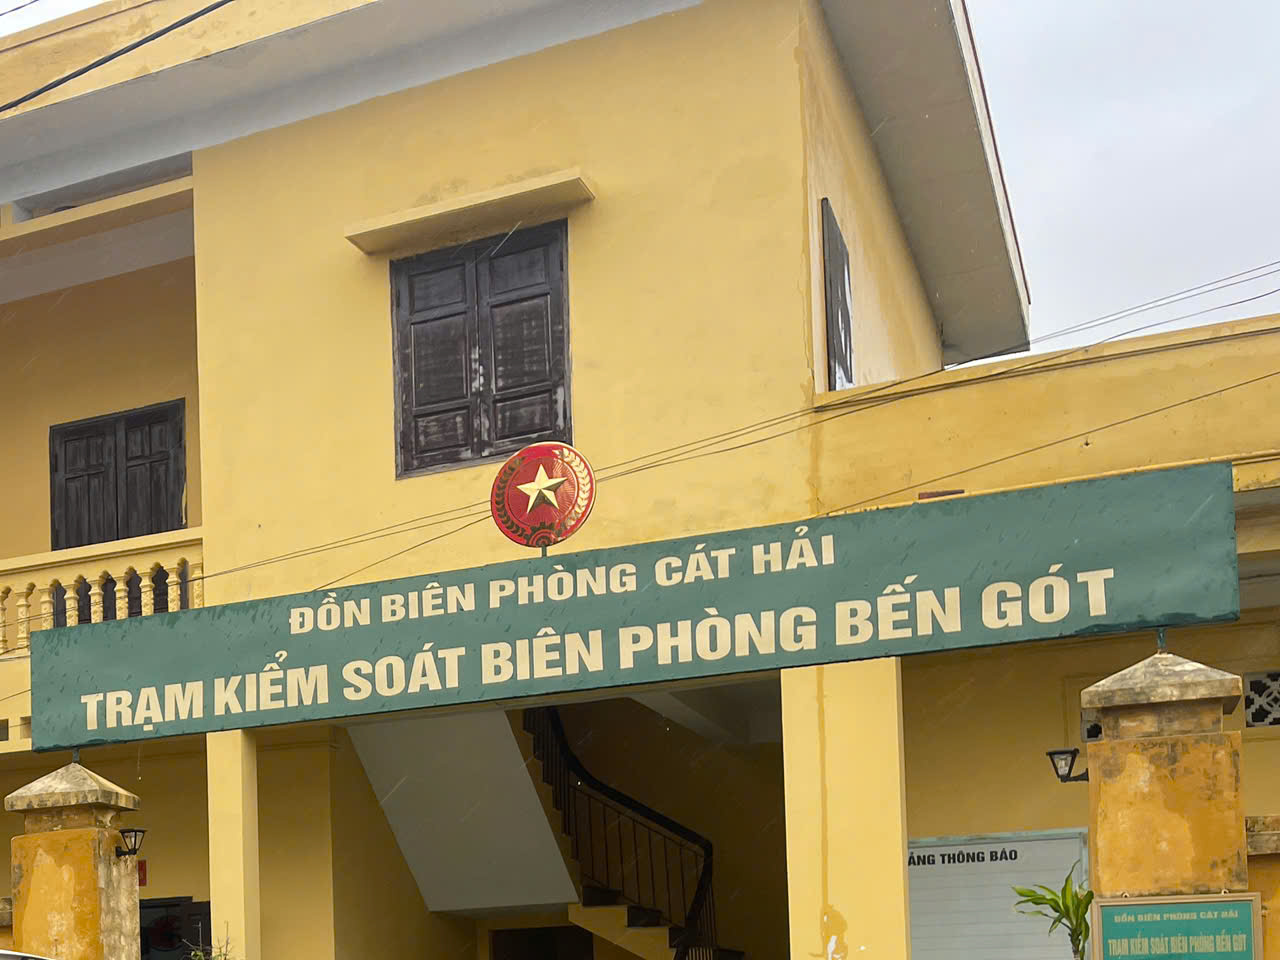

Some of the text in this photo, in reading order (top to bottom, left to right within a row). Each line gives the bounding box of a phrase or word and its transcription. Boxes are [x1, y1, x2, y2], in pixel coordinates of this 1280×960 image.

[289, 525, 835, 635] ĐỒN BIÊN PHÒNG CÁT HẢI
[80, 563, 1115, 732] TRẠM KIỂM SOÁT BIÊN PHÒNG BẾN GÓT
[908, 852, 936, 867] ẢNG
[940, 850, 986, 865] THÔNG
